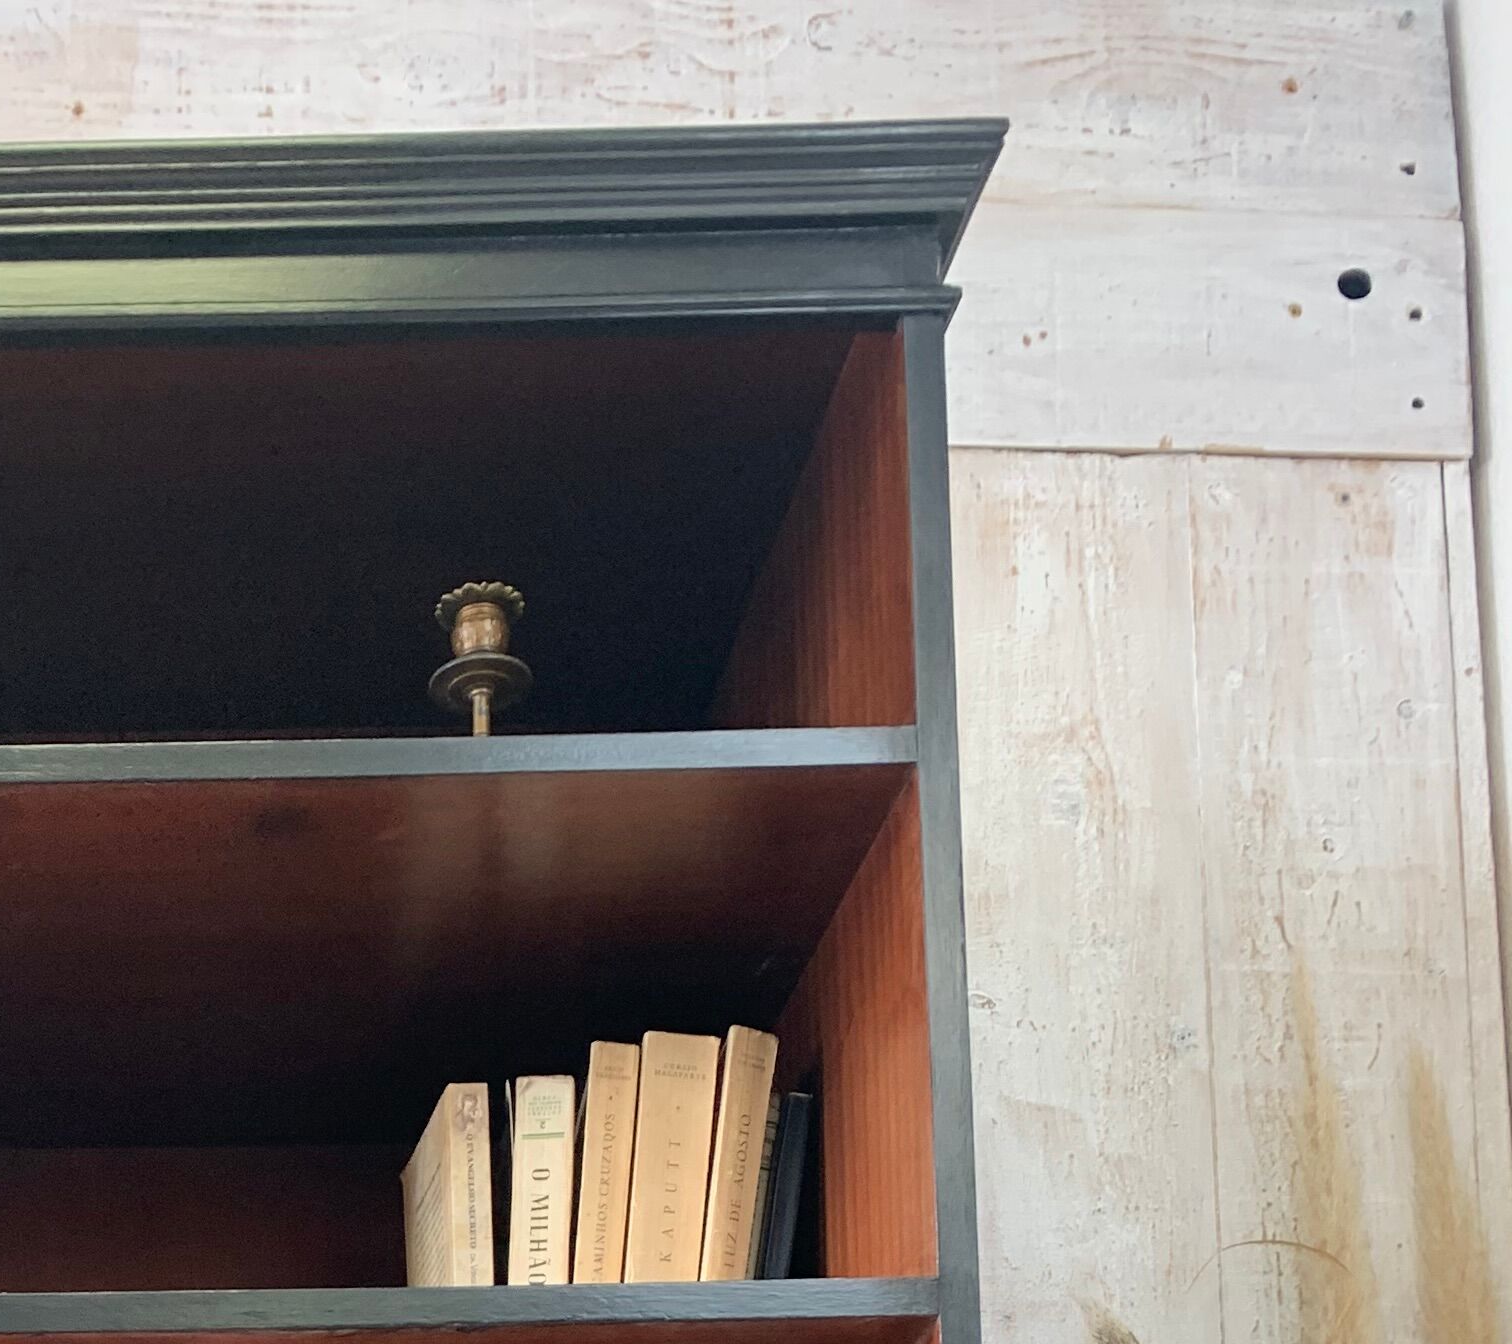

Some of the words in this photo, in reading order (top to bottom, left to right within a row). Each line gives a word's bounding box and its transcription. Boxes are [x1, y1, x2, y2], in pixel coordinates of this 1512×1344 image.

[530, 1167, 551, 1182] O
[598, 1112, 616, 1198] CRUZADOS
[733, 1113, 752, 1189] AGOSTO
[468, 1204, 477, 1249] SECRETO
[528, 1192, 551, 1285] MILHÃO
[658, 1137, 681, 1264] KAPUTT
[728, 1199, 741, 1223] DE
